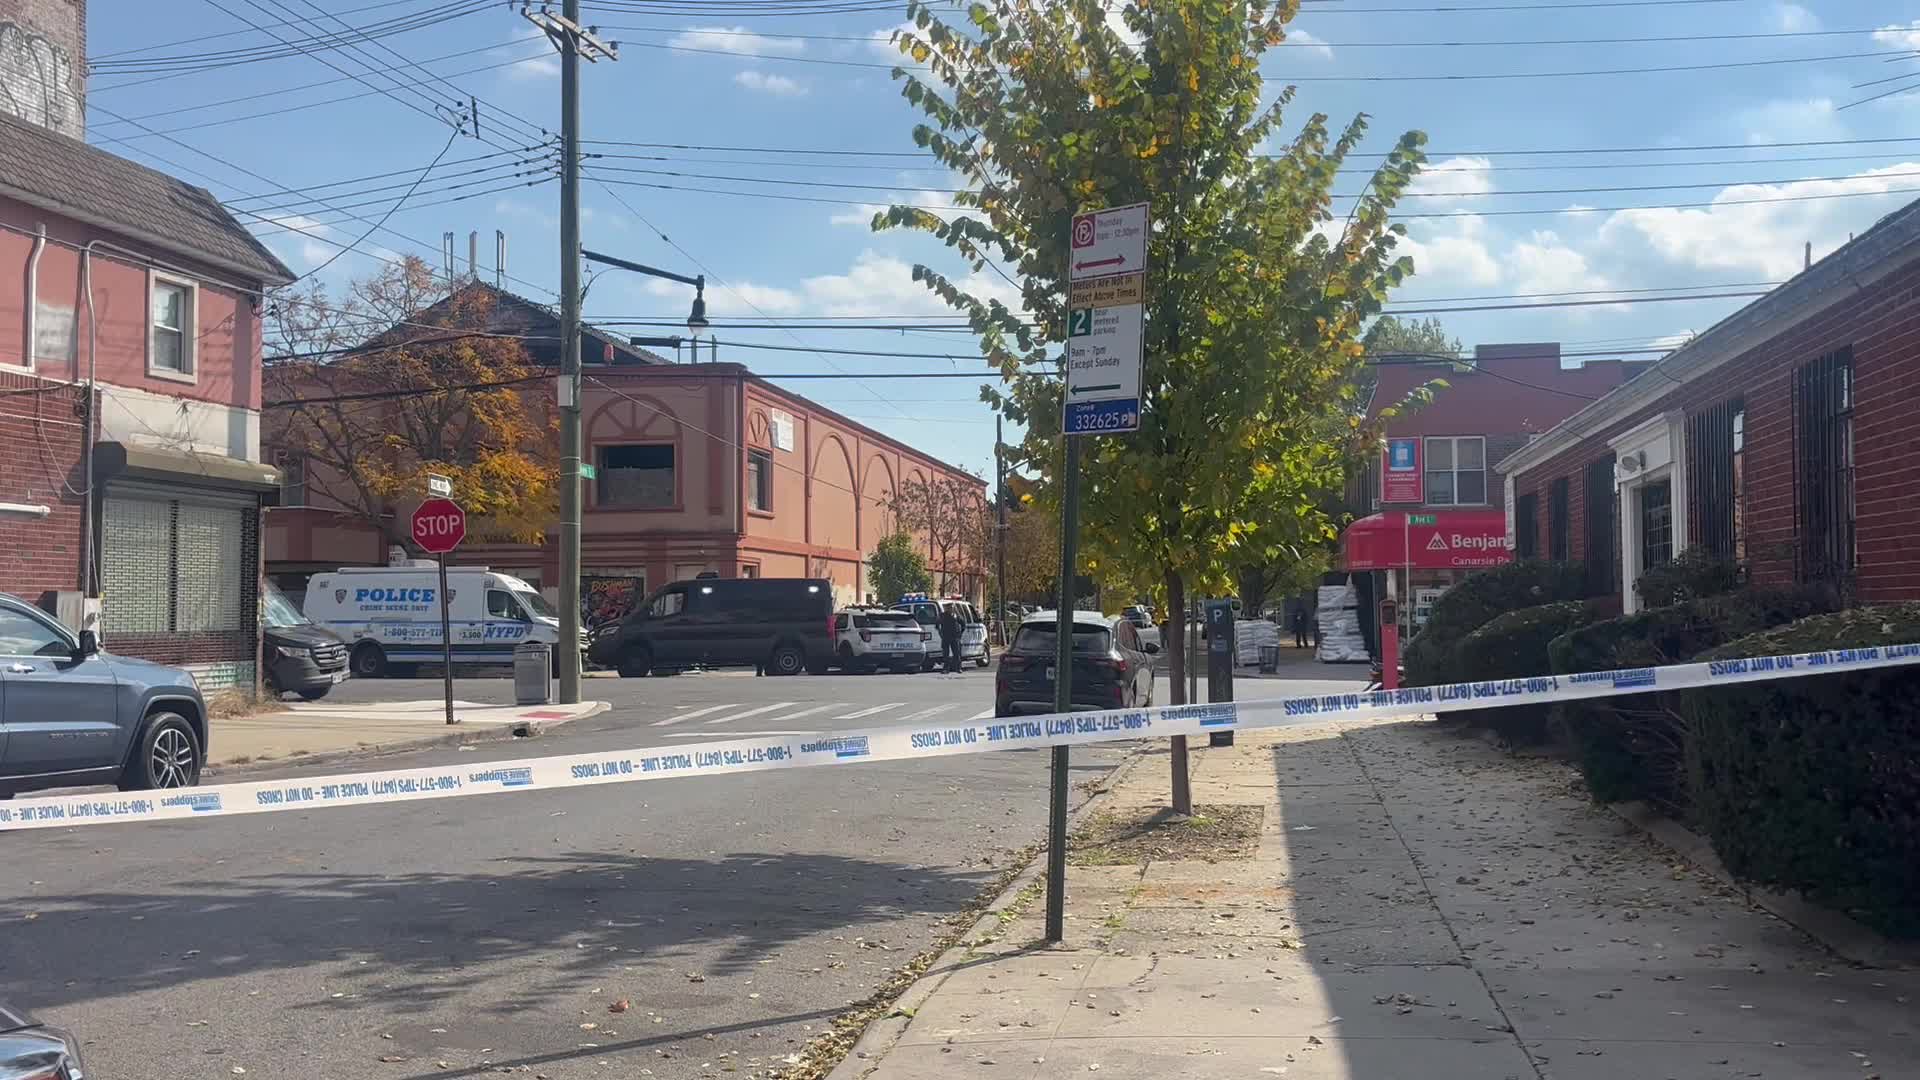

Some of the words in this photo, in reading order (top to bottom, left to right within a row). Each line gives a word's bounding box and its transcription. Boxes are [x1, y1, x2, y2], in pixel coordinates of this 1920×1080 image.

[1097, 279, 1109, 288] Are
[1111, 277, 1124, 287] Not
[1072, 293, 1092, 304] Effect
[1093, 290, 1115, 301] Above
[1117, 288, 1137, 298] Times
[1074, 309, 1086, 334] 2
[1092, 345, 1106, 356] 7pm
[1070, 359, 1094, 370] Except
[1095, 356, 1120, 369] Sunday
[1075, 412, 1119, 430] 332625
[416, 515, 460, 537] STOP
[1451, 556, 1495, 566] Canarsie
[355, 588, 436, 602] POLICE
[1213, 609, 1223, 624] P
[485, 626, 524, 638] NYPD
[1343, 694, 1358, 710] DO
[1370, 690, 1393, 707] LINE
[1397, 687, 1432, 705] POLICE
[1284, 698, 1318, 716] CROSS
[1321, 696, 1342, 712] NOT
[1046, 718, 1075, 737] (8477)
[1077, 711, 1152, 733] 1-800-577-TIPS
[943, 730, 961, 744] NOT
[963, 728, 976, 743] DO
[987, 724, 1007, 740] LINE
[1008, 721, 1041, 739] POLICE
[911, 732, 941, 748] CROSS
[662, 754, 692, 770] POLICE
[695, 751, 723, 768] (8477)
[724, 746, 792, 764] 1-800-577-TIPS
[571, 763, 599, 778] CROSS
[601, 762, 617, 776] NOT
[619, 760, 632, 774] DO
[641, 757, 661, 771] LINE
[321, 785, 339, 798] LINE
[340, 782, 368, 797] POLICE
[372, 779, 398, 795] (8477)
[398, 775, 462, 793] 1-800-577-TIPS
[256, 789, 283, 804] CROSS
[285, 788, 302, 802] NOT
[302, 787, 314, 801] DO
[0, 809, 12, 822] DO
[20, 807, 37, 820] LINE
[38, 805, 64, 819] POLICE
[68, 803, 93, 817] (8477)
[94, 800, 154, 816] 1-800-577-TIPS
